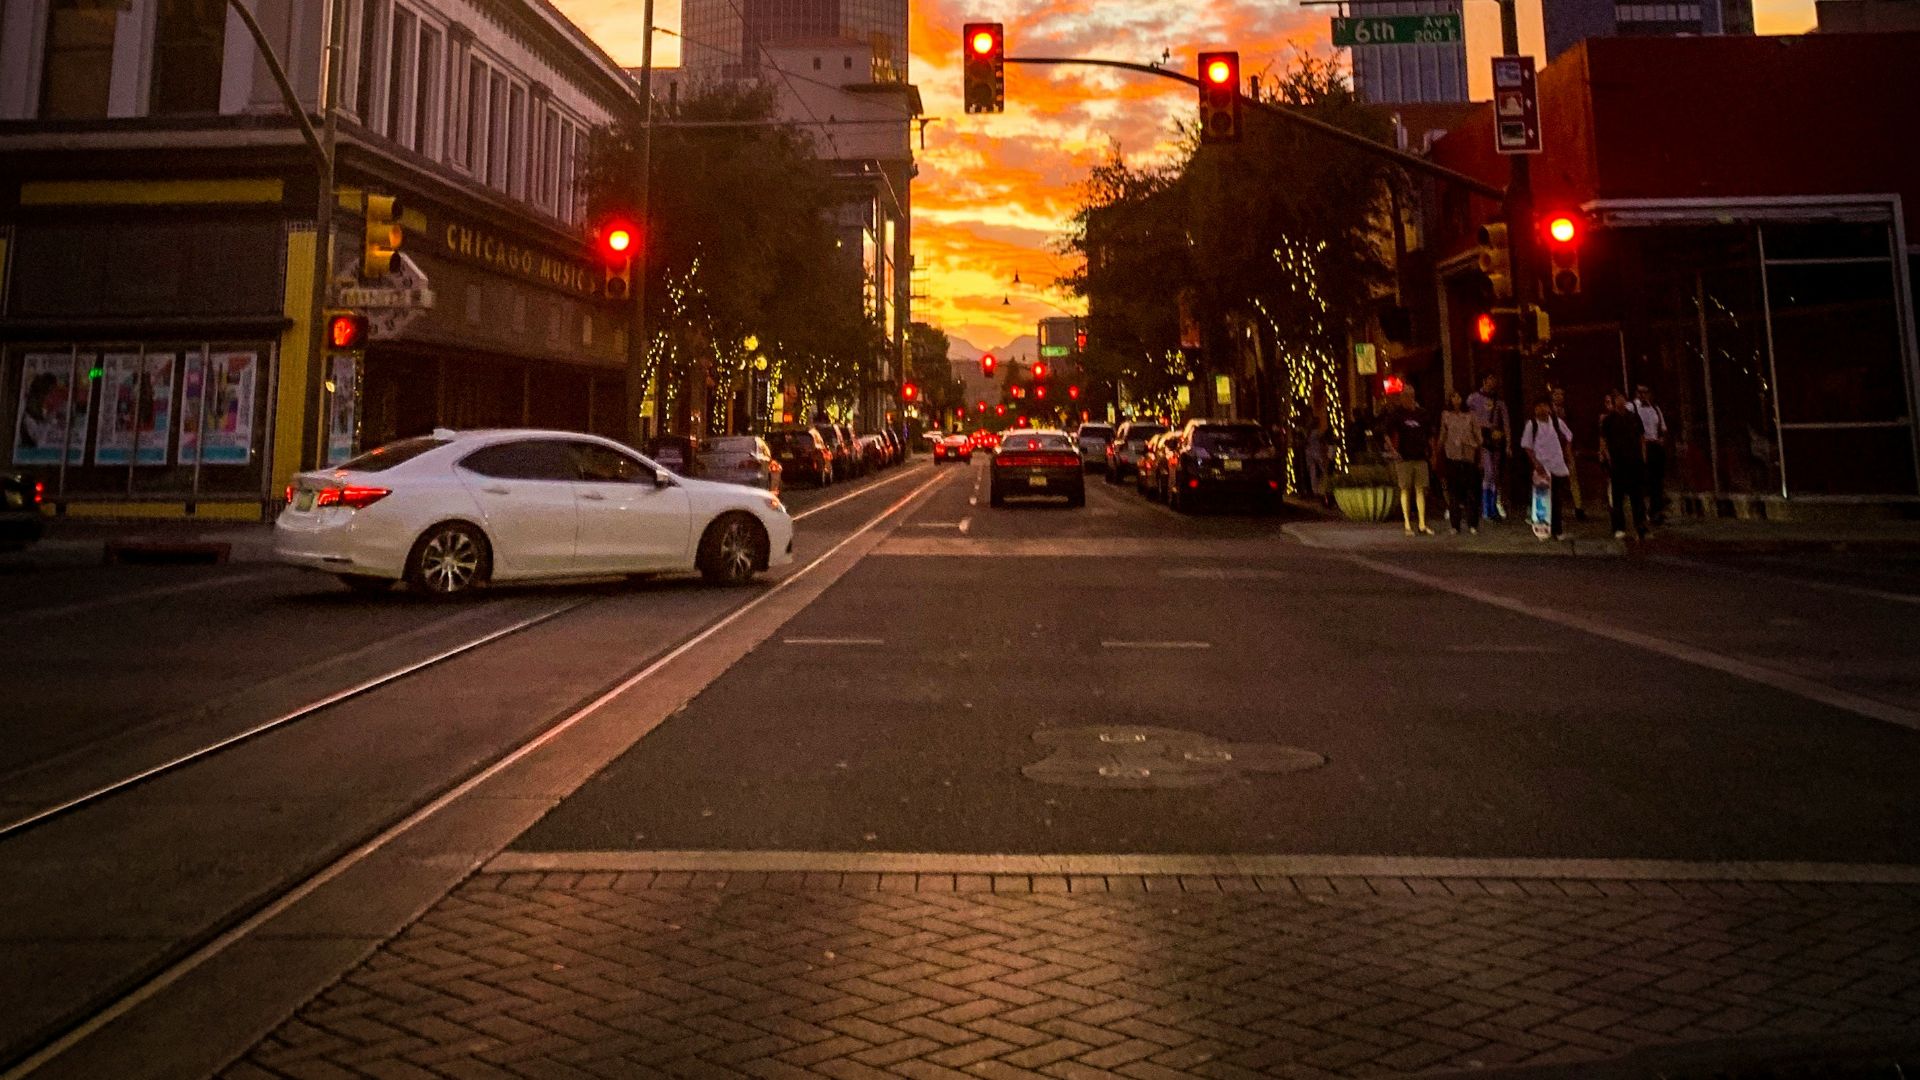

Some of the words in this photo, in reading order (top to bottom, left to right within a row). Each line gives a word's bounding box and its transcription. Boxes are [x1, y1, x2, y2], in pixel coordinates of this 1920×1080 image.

[1337, 18, 1346, 31] N
[1355, 20, 1395, 43] 6th
[1423, 16, 1452, 28] Ave
[1414, 30, 1442, 43] 200
[447, 223, 533, 275] CHICAGO
[540, 255, 584, 291] MUSIC
